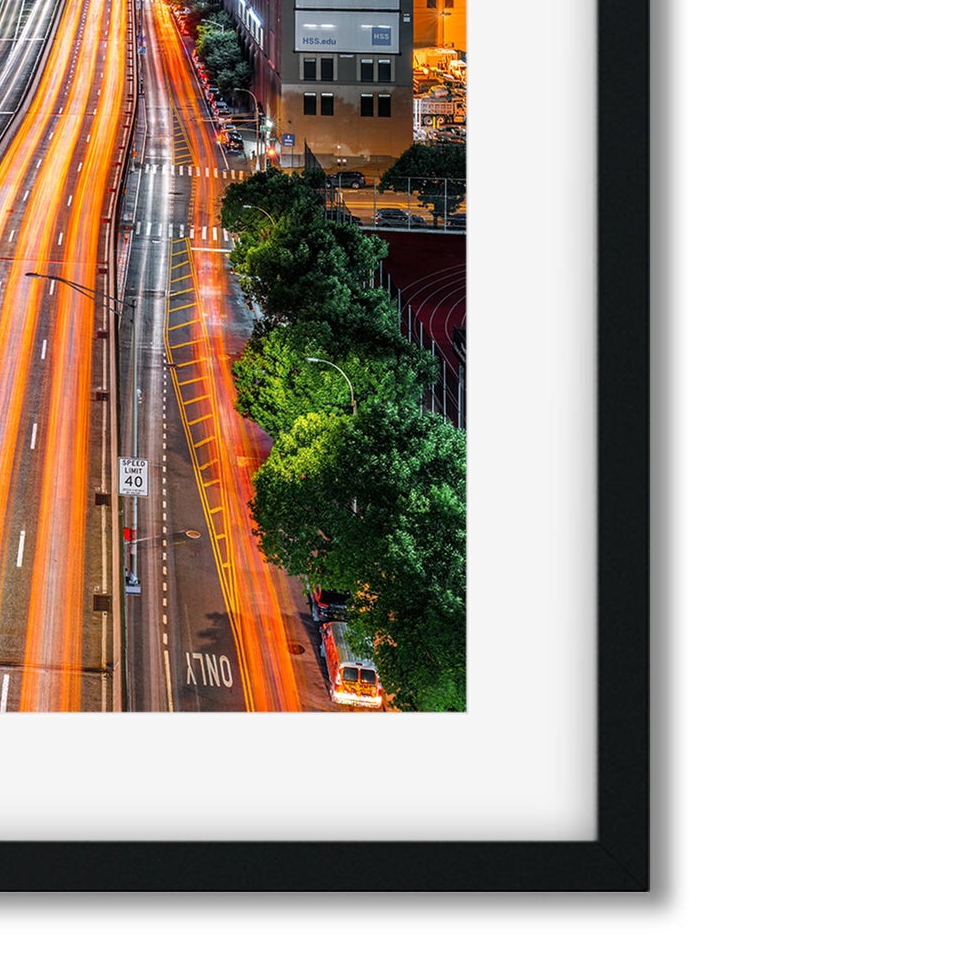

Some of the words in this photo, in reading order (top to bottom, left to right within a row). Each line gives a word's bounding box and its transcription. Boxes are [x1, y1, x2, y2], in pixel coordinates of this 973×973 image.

[302, 37, 337, 45] HSS.edu
[122, 459, 146, 467] SPEED
[124, 476, 142, 488] 40
[186, 652, 233, 688] ONLY
